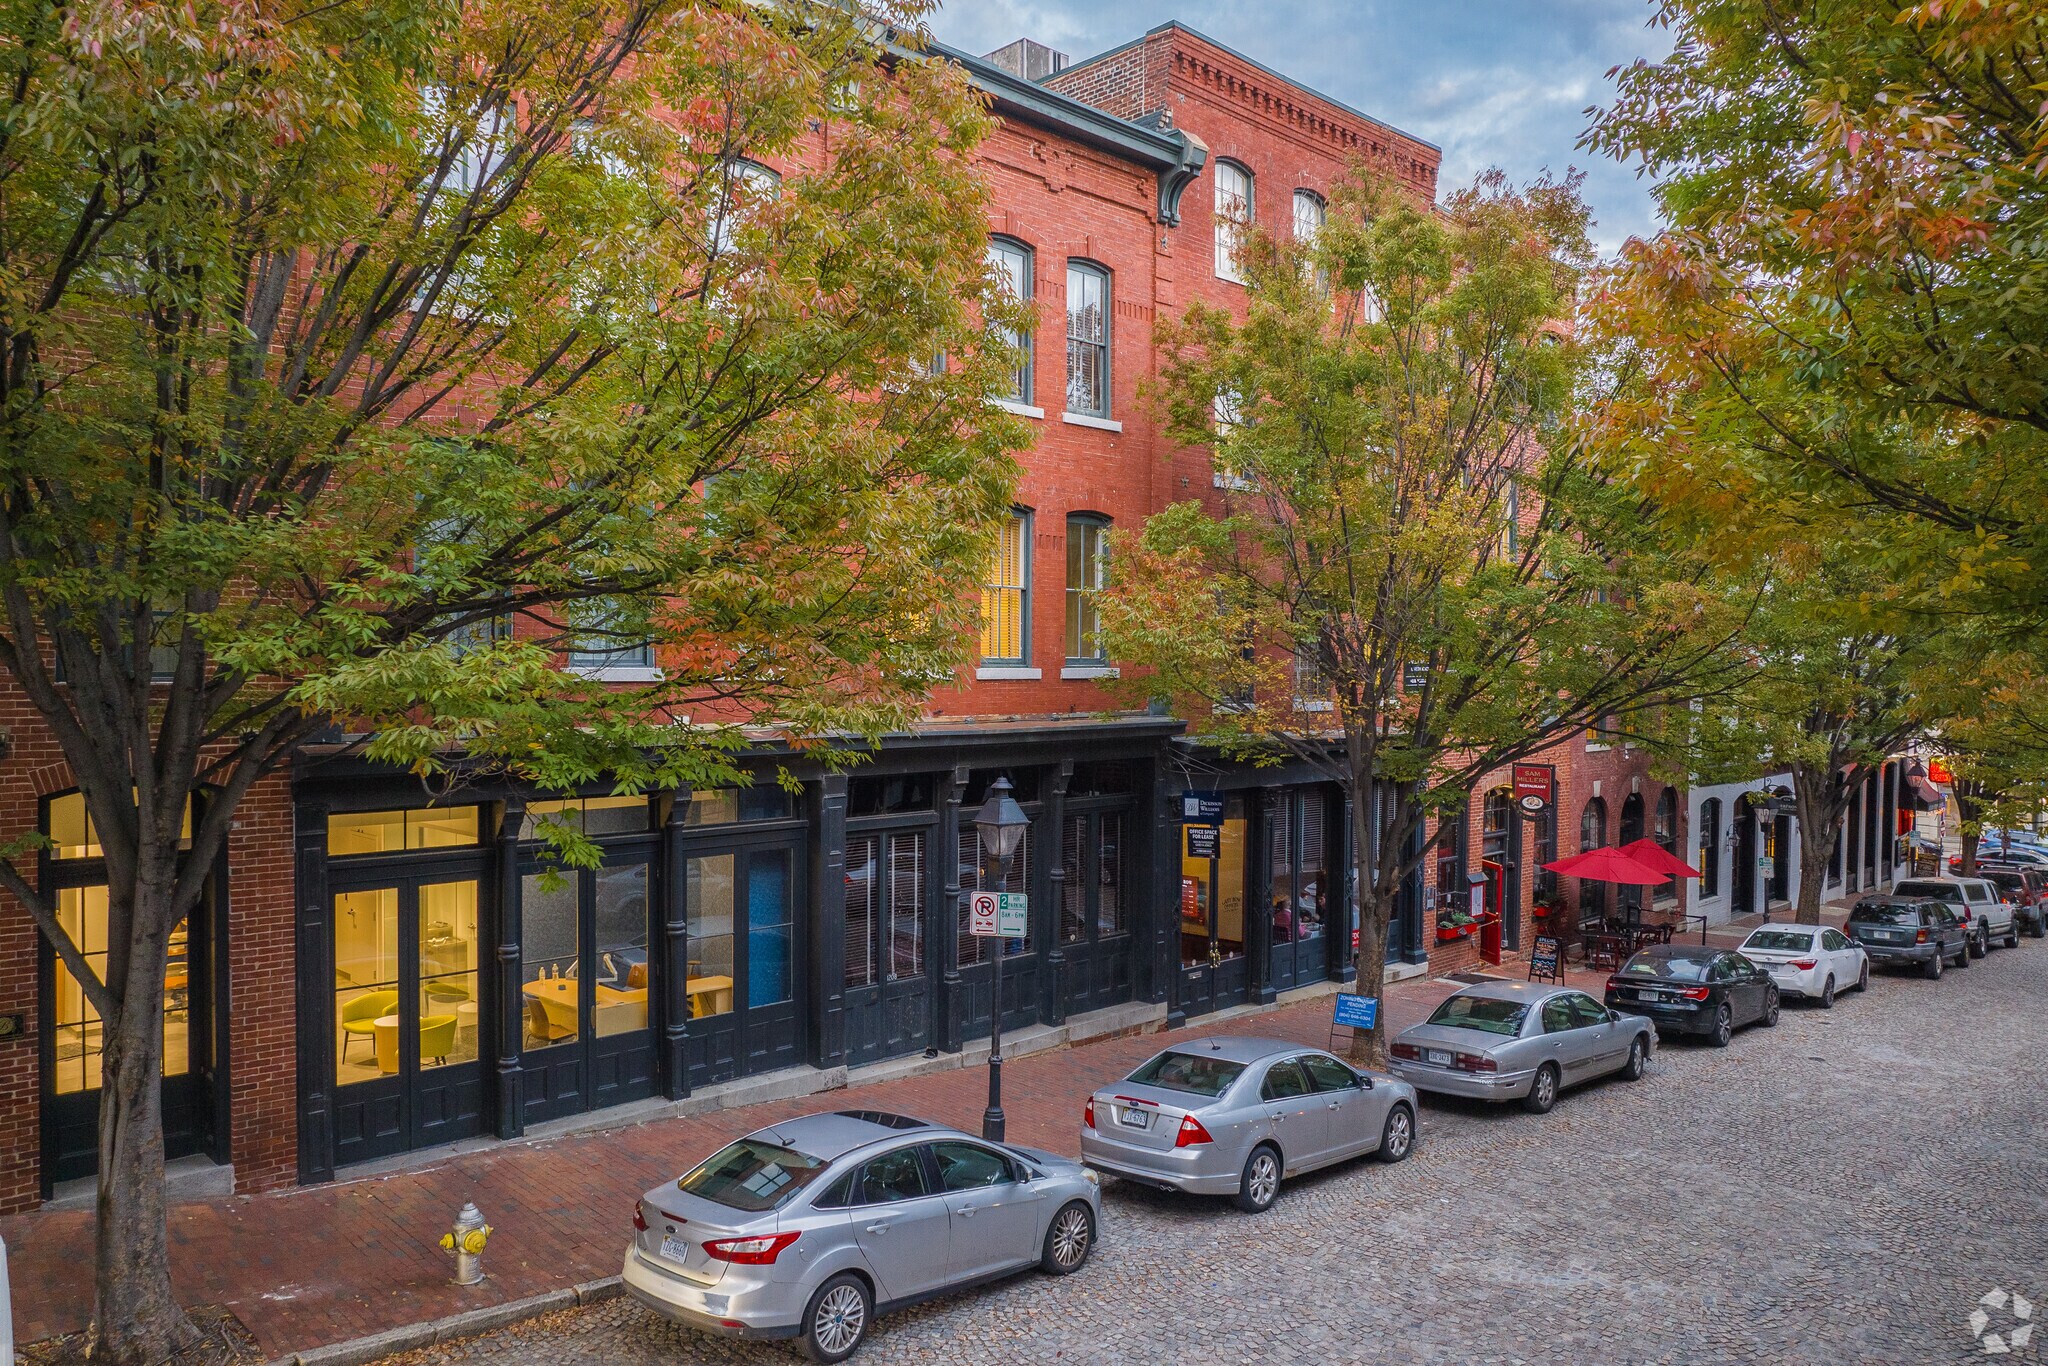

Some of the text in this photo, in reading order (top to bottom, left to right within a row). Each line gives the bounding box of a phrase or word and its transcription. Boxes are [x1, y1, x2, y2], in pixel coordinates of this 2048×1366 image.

[1516, 776, 1549, 784] MILLERS
[1001, 896, 1007, 907] 2
[1346, 1001, 1366, 1009] PENDING
